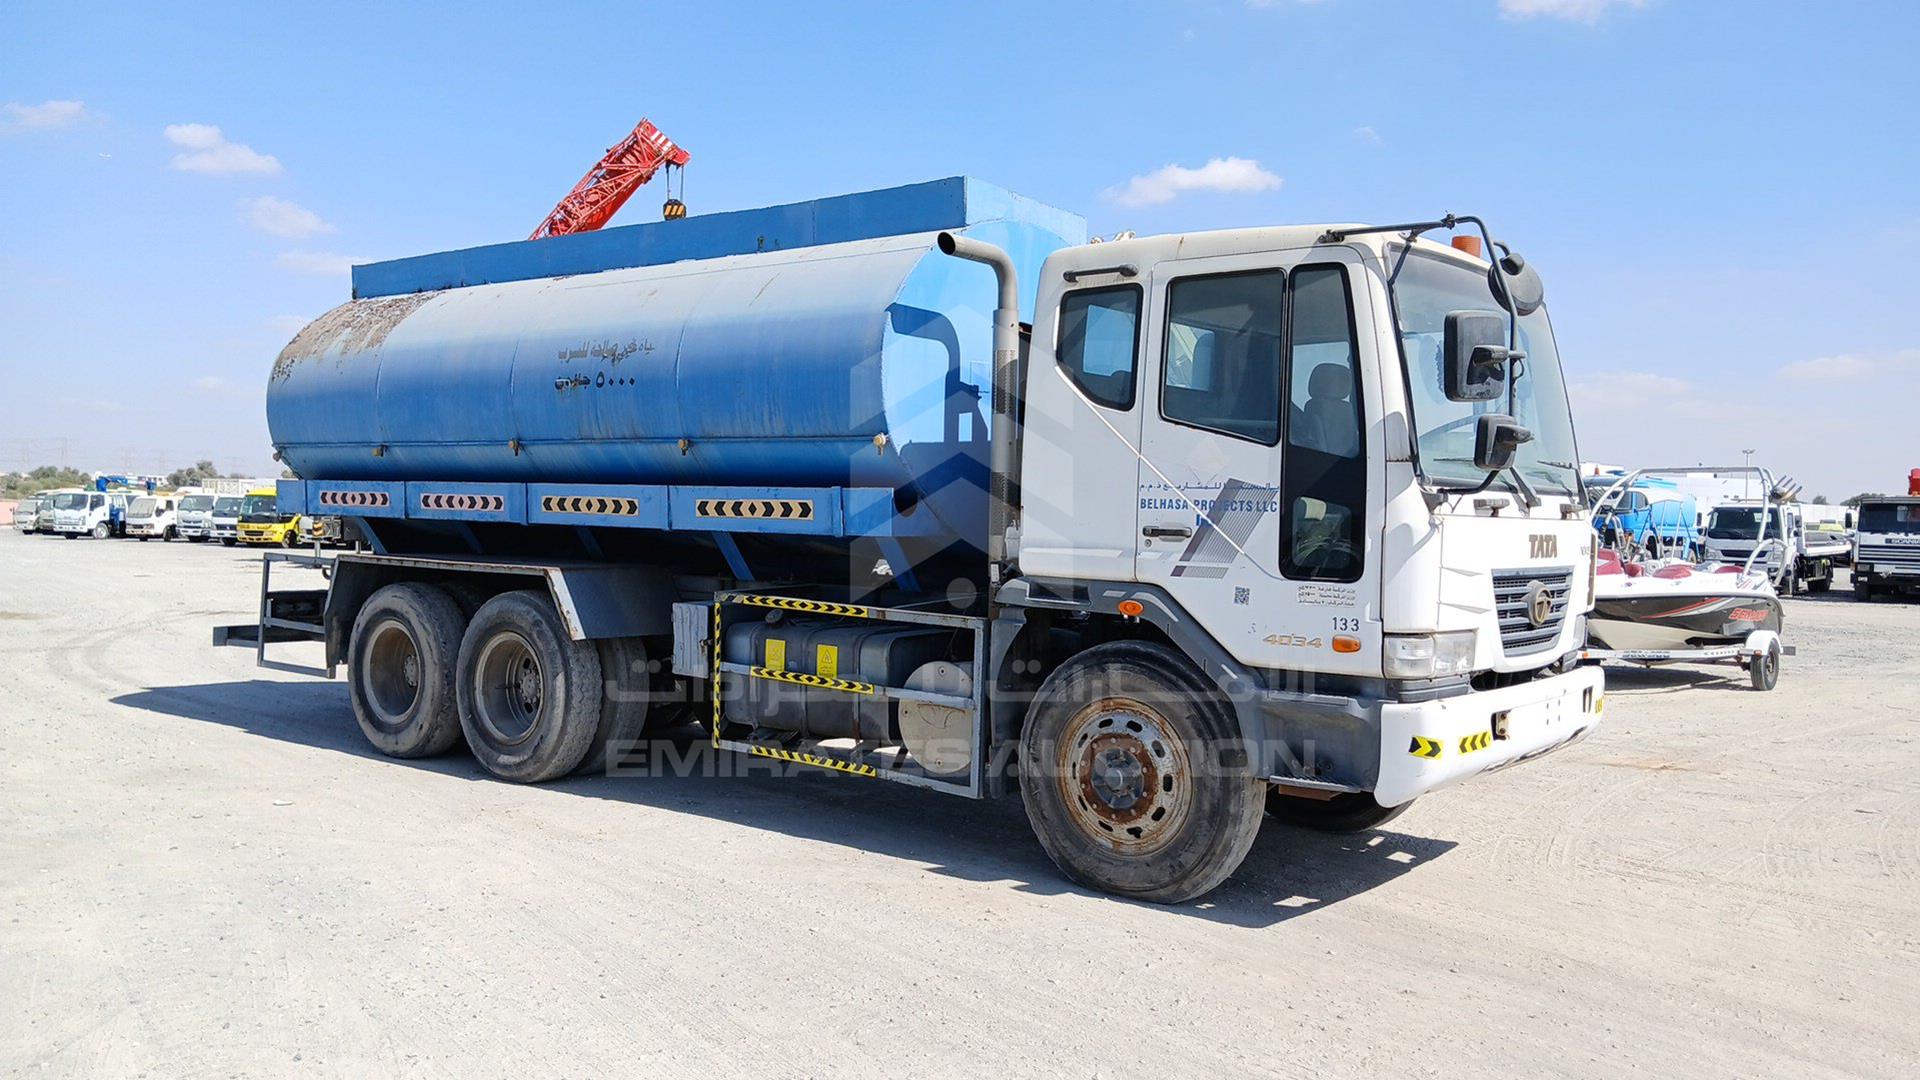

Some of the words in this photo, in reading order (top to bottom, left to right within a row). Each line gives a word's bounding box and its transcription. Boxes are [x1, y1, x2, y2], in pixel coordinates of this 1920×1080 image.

[1140, 498, 1189, 510] BELHASA
[1193, 499, 1253, 512] PROECTS
[1256, 501, 1277, 512] LLC
[1528, 534, 1558, 559] TATA
[1332, 616, 1360, 632] 133
[1262, 634, 1322, 648] 4034
